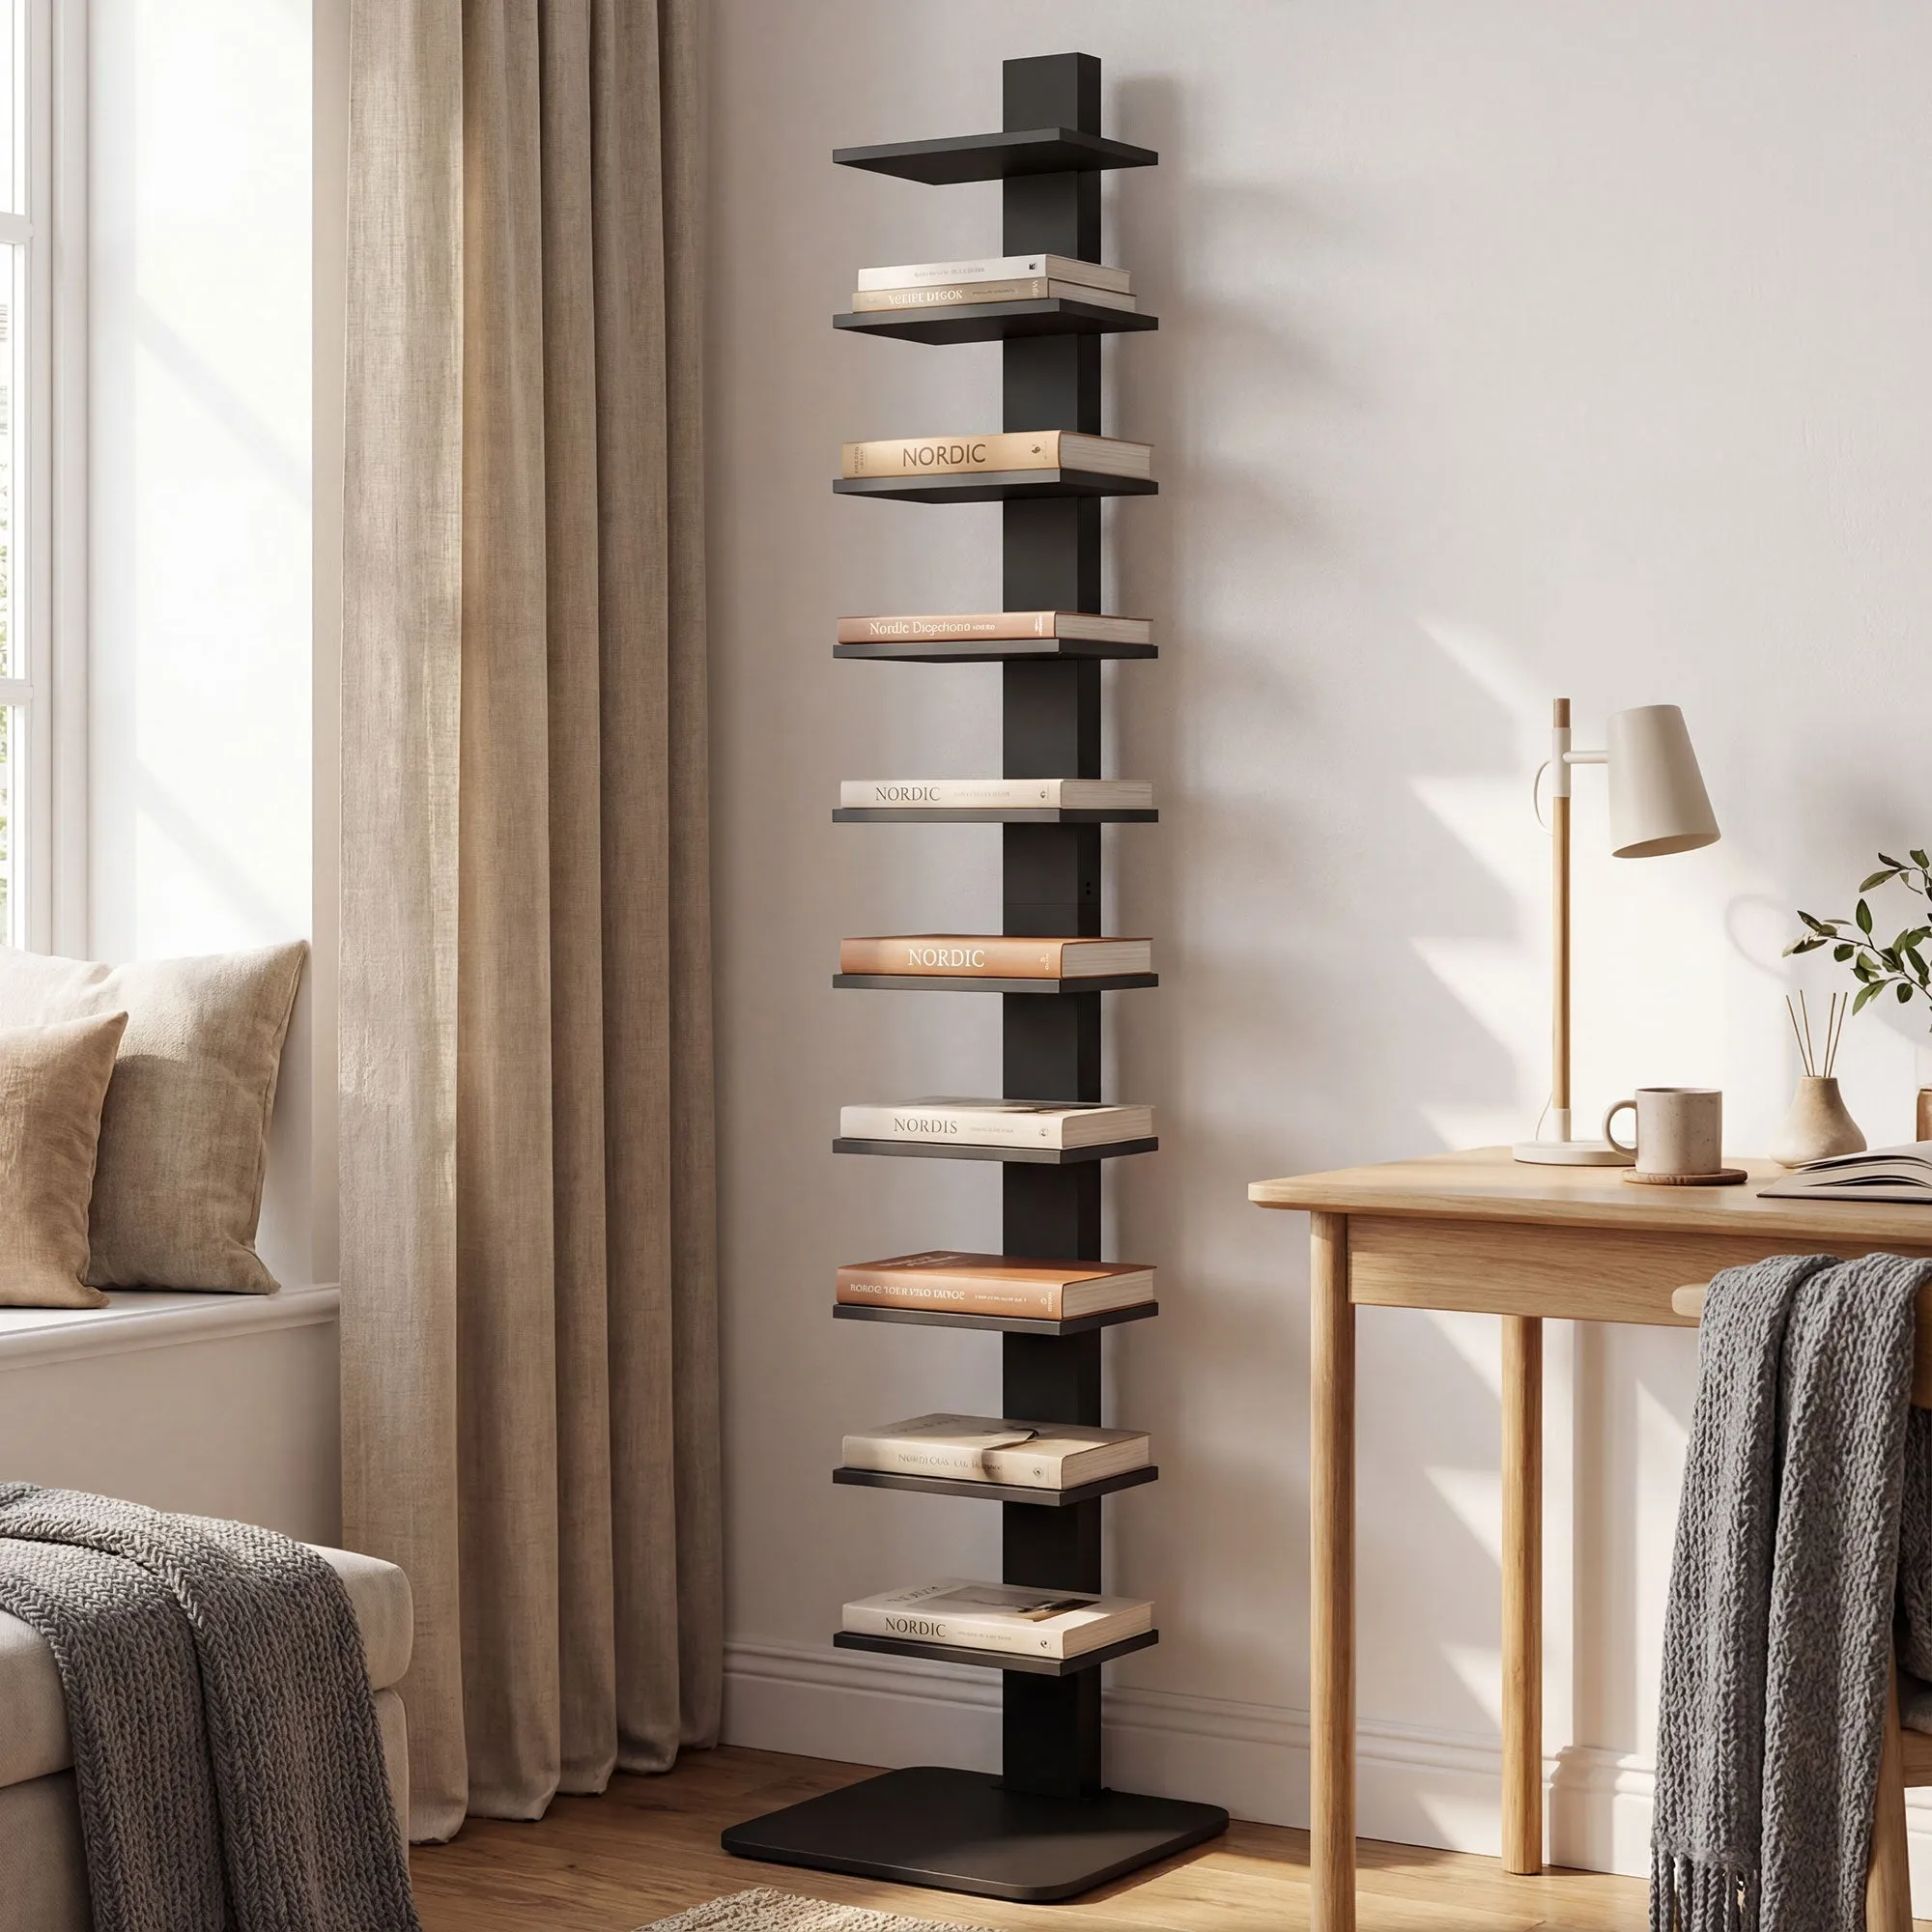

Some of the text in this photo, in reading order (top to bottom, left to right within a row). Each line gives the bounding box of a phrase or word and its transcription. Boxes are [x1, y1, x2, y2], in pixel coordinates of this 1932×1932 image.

[903, 443, 986, 467] NORDIC
[875, 786, 941, 802] NORDIC
[908, 949, 985, 967] NORDIC
[894, 1118, 957, 1134] NORDIS
[885, 1617, 947, 1637] NORDIC
